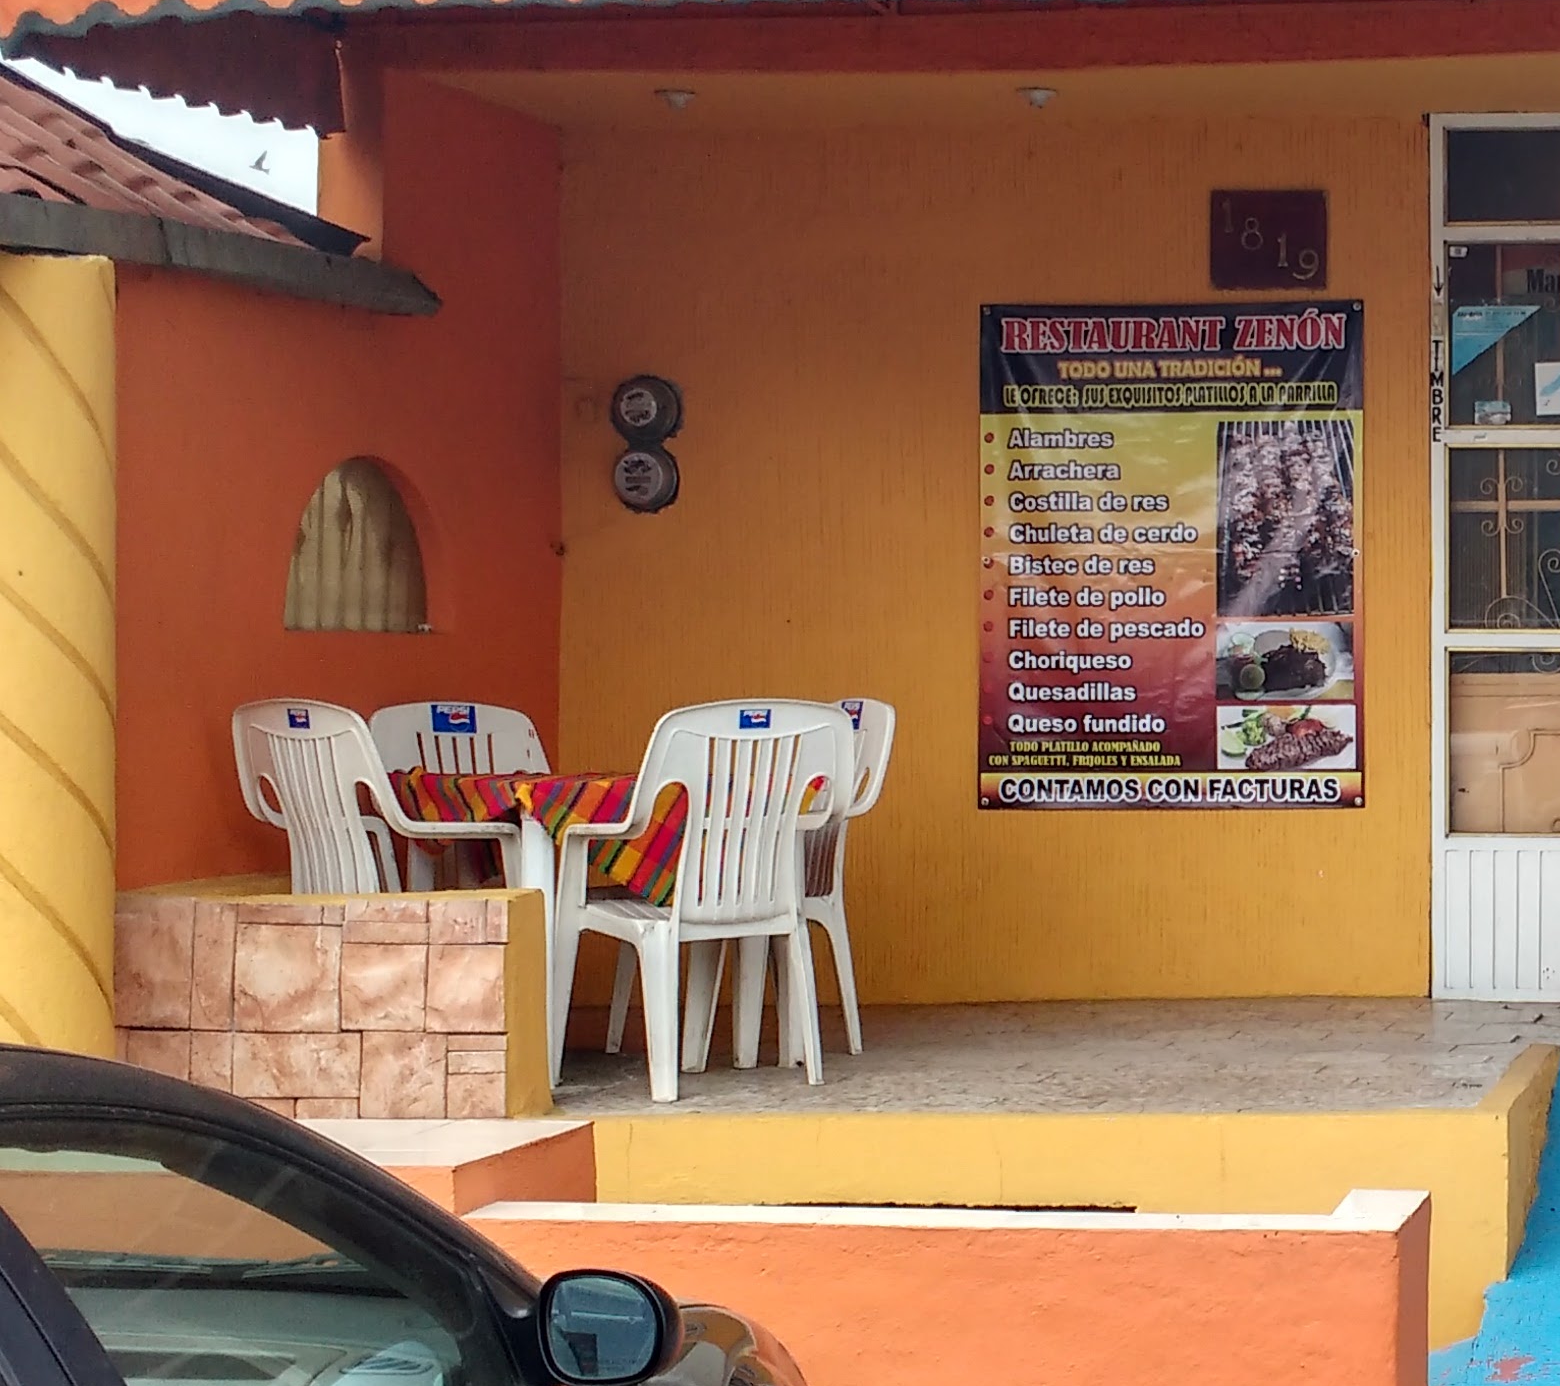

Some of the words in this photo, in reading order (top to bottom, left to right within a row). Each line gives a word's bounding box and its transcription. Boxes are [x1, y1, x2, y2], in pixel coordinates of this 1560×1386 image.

[1001, 315, 1226, 353] RESTAURANT
[1233, 308, 1346, 350] ZENÓN
[1058, 360, 1112, 379] TODO
[1114, 359, 1157, 378] UNA
[1158, 354, 1261, 377] TRADICIÓN
[1083, 384, 1106, 407] SUS
[1107, 383, 1182, 407] EXQUISITOS
[1183, 382, 1248, 406] PLATILLOS
[1250, 382, 1259, 405] A
[1260, 382, 1275, 405] LA
[1278, 381, 1338, 405] PARRILLA
[1430, 339, 1444, 443] TIMBRE
[1008, 428, 1114, 448] Alambres
[1008, 460, 1120, 481] Arrachera
[1009, 492, 1092, 511] Costilla
[1100, 492, 1126, 511] de
[1132, 495, 1169, 511] res
[1009, 524, 1092, 543] Chuleta
[1099, 524, 1127, 543] de
[1133, 523, 1198, 542] cerdo
[1008, 556, 1077, 575] Bistec
[1084, 555, 1111, 574] de
[1117, 558, 1155, 574] res
[1008, 587, 1071, 606] Filete
[1076, 586, 1103, 606] de
[1109, 586, 1166, 610] pollo
[1008, 619, 1071, 638] Filete
[1076, 618, 1103, 638] de
[1109, 617, 1206, 642] pescado
[1008, 650, 1132, 673] Choriqueso
[1008, 682, 1137, 702] Quesadillas
[1008, 713, 1077, 733] Queso
[1083, 713, 1166, 733] fundido
[1009, 741, 1038, 752] TODO
[1041, 741, 1089, 752] PLATILLO
[1091, 739, 1161, 752] ACOMPAÑADO
[988, 755, 1009, 766] CON
[1011, 755, 1069, 767] SPAGUETTI,
[1072, 755, 1118, 767] FRIJOLES
[1120, 755, 1128, 766] Y
[1130, 755, 1181, 766] ENSALADA
[1000, 777, 1141, 802] CONTAMOS
[1147, 776, 1201, 802] CON
[1207, 776, 1340, 802] FACTURAS
